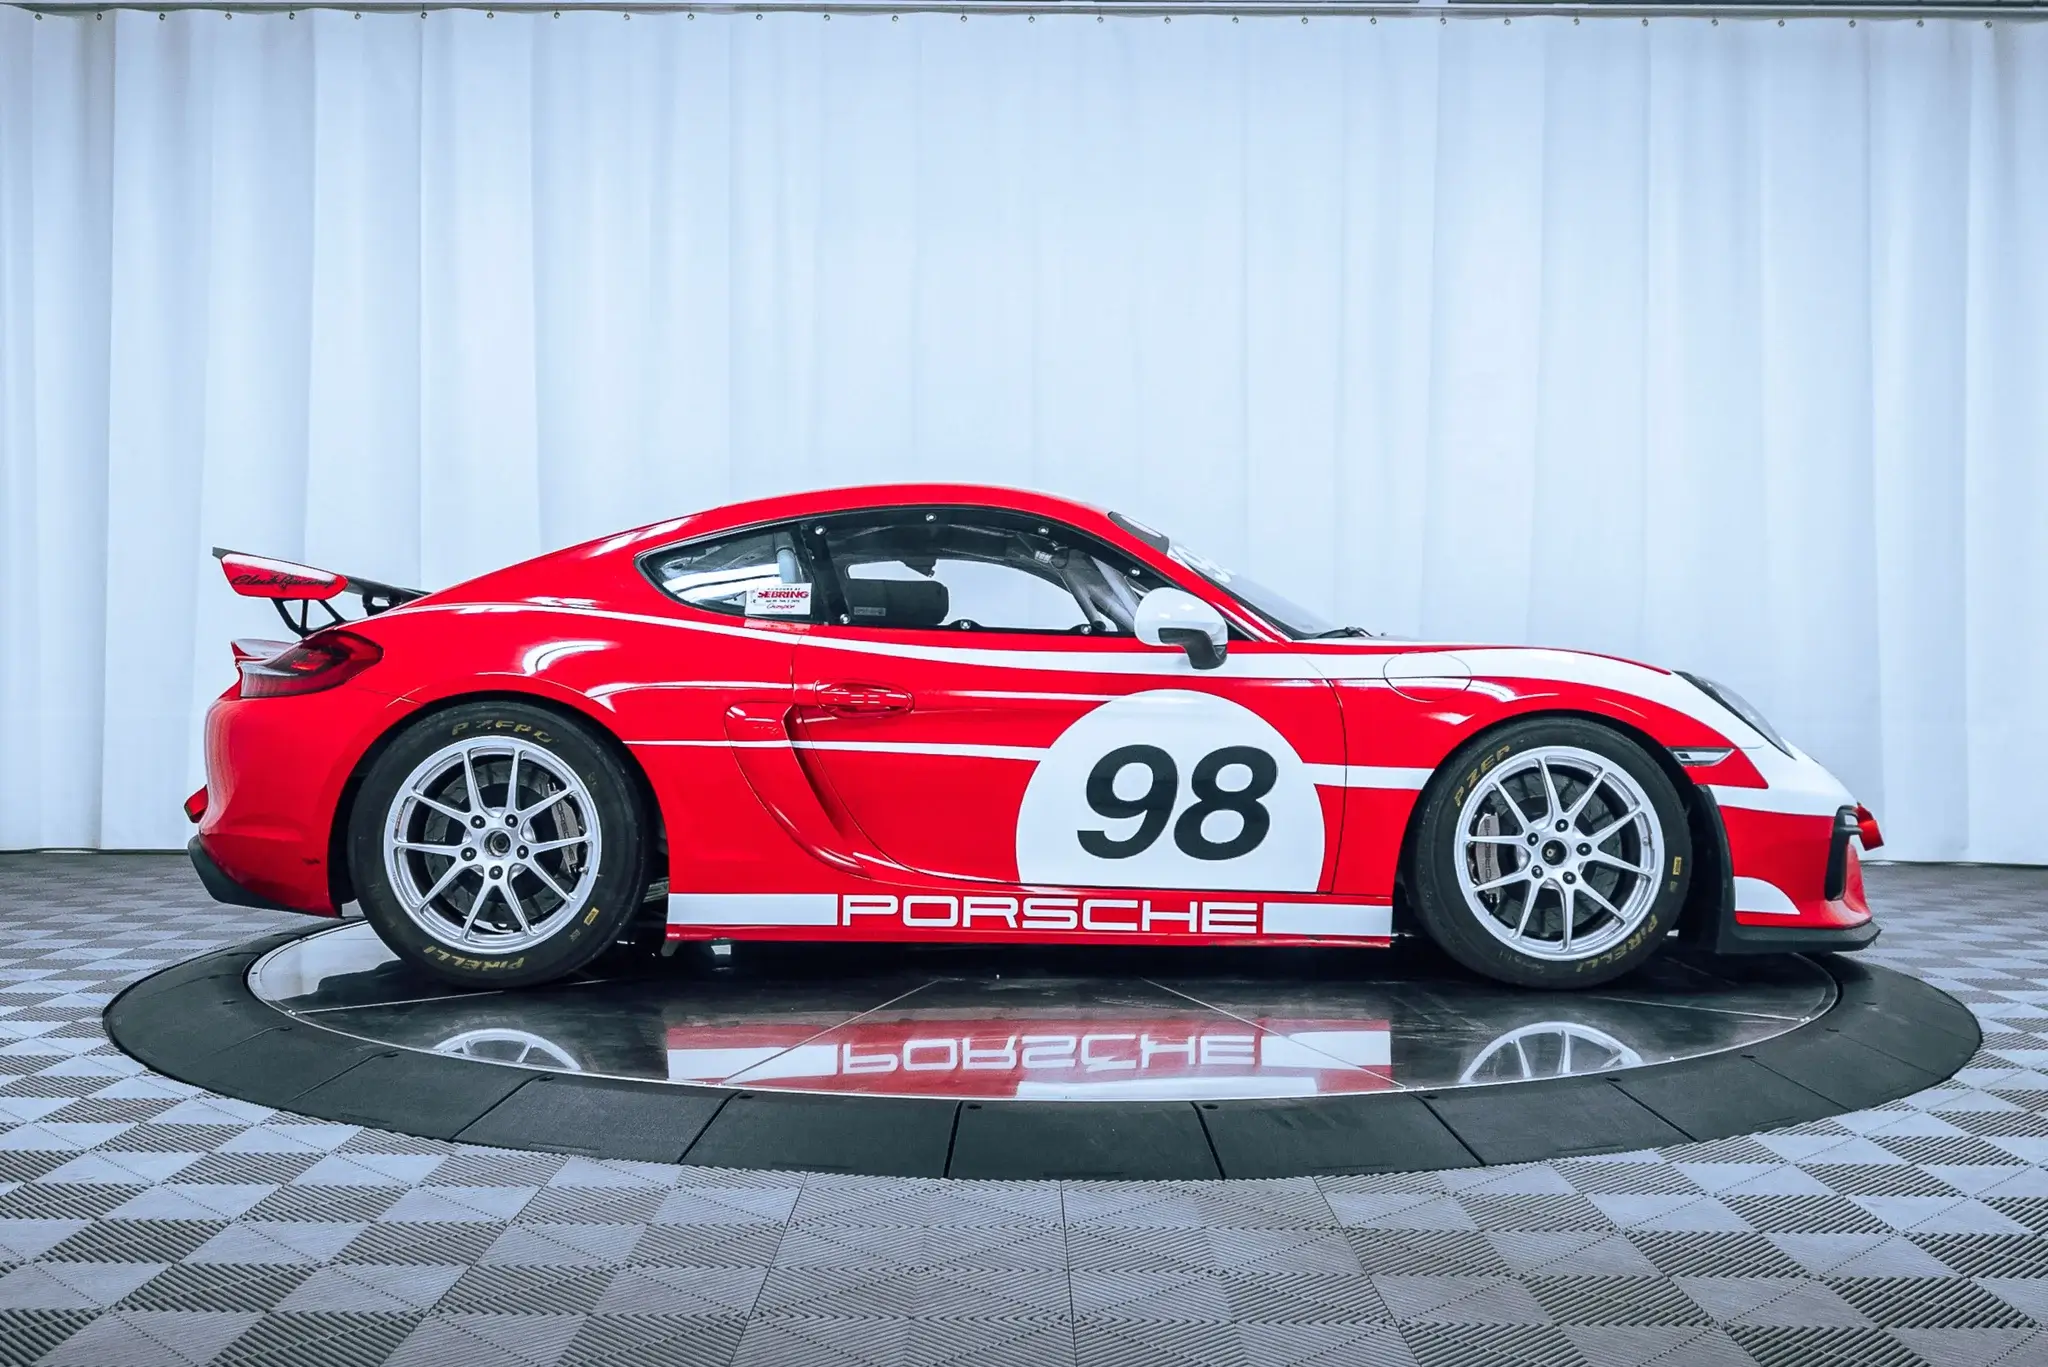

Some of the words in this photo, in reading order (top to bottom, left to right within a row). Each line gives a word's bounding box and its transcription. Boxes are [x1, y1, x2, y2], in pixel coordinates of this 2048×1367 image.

[757, 590, 809, 599] SEBRING
[1077, 744, 1278, 860] 98
[842, 895, 1258, 933] PORSCHE
